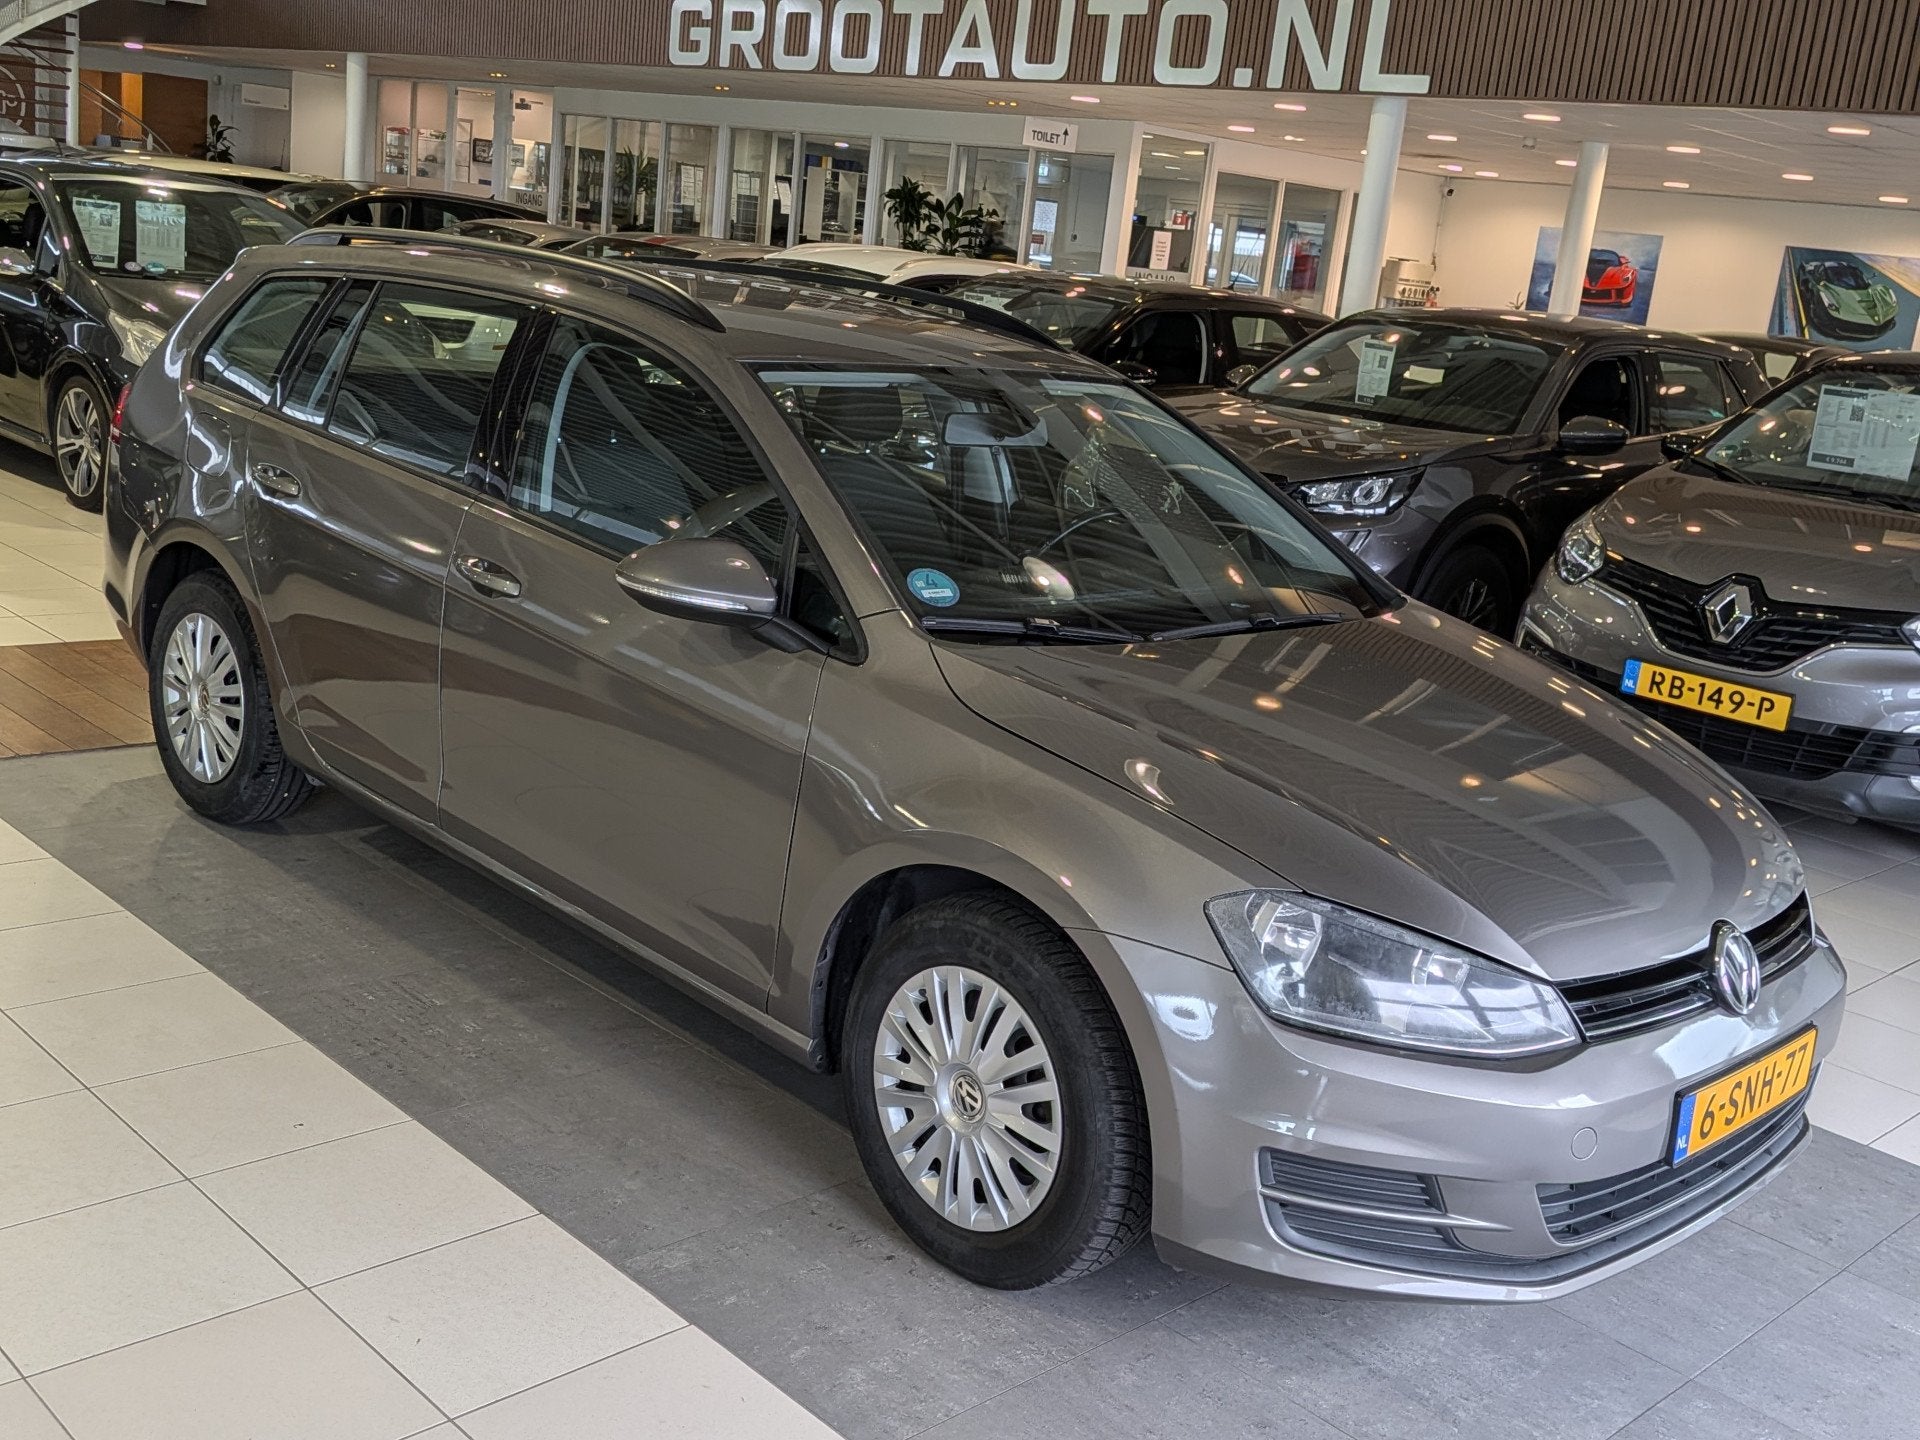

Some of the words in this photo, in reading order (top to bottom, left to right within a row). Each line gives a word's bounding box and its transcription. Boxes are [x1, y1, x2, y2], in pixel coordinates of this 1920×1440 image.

[669, 0, 1431, 94] GROOTAUTO.NL
[1031, 129, 1061, 145] TOILET
[515, 192, 543, 207] INGANG
[1624, 678, 1635, 689] NL
[1648, 670, 1776, 720] RB-149-P
[1677, 1134, 1688, 1149] NL
[1699, 1042, 1809, 1140] 6-SNH-77
